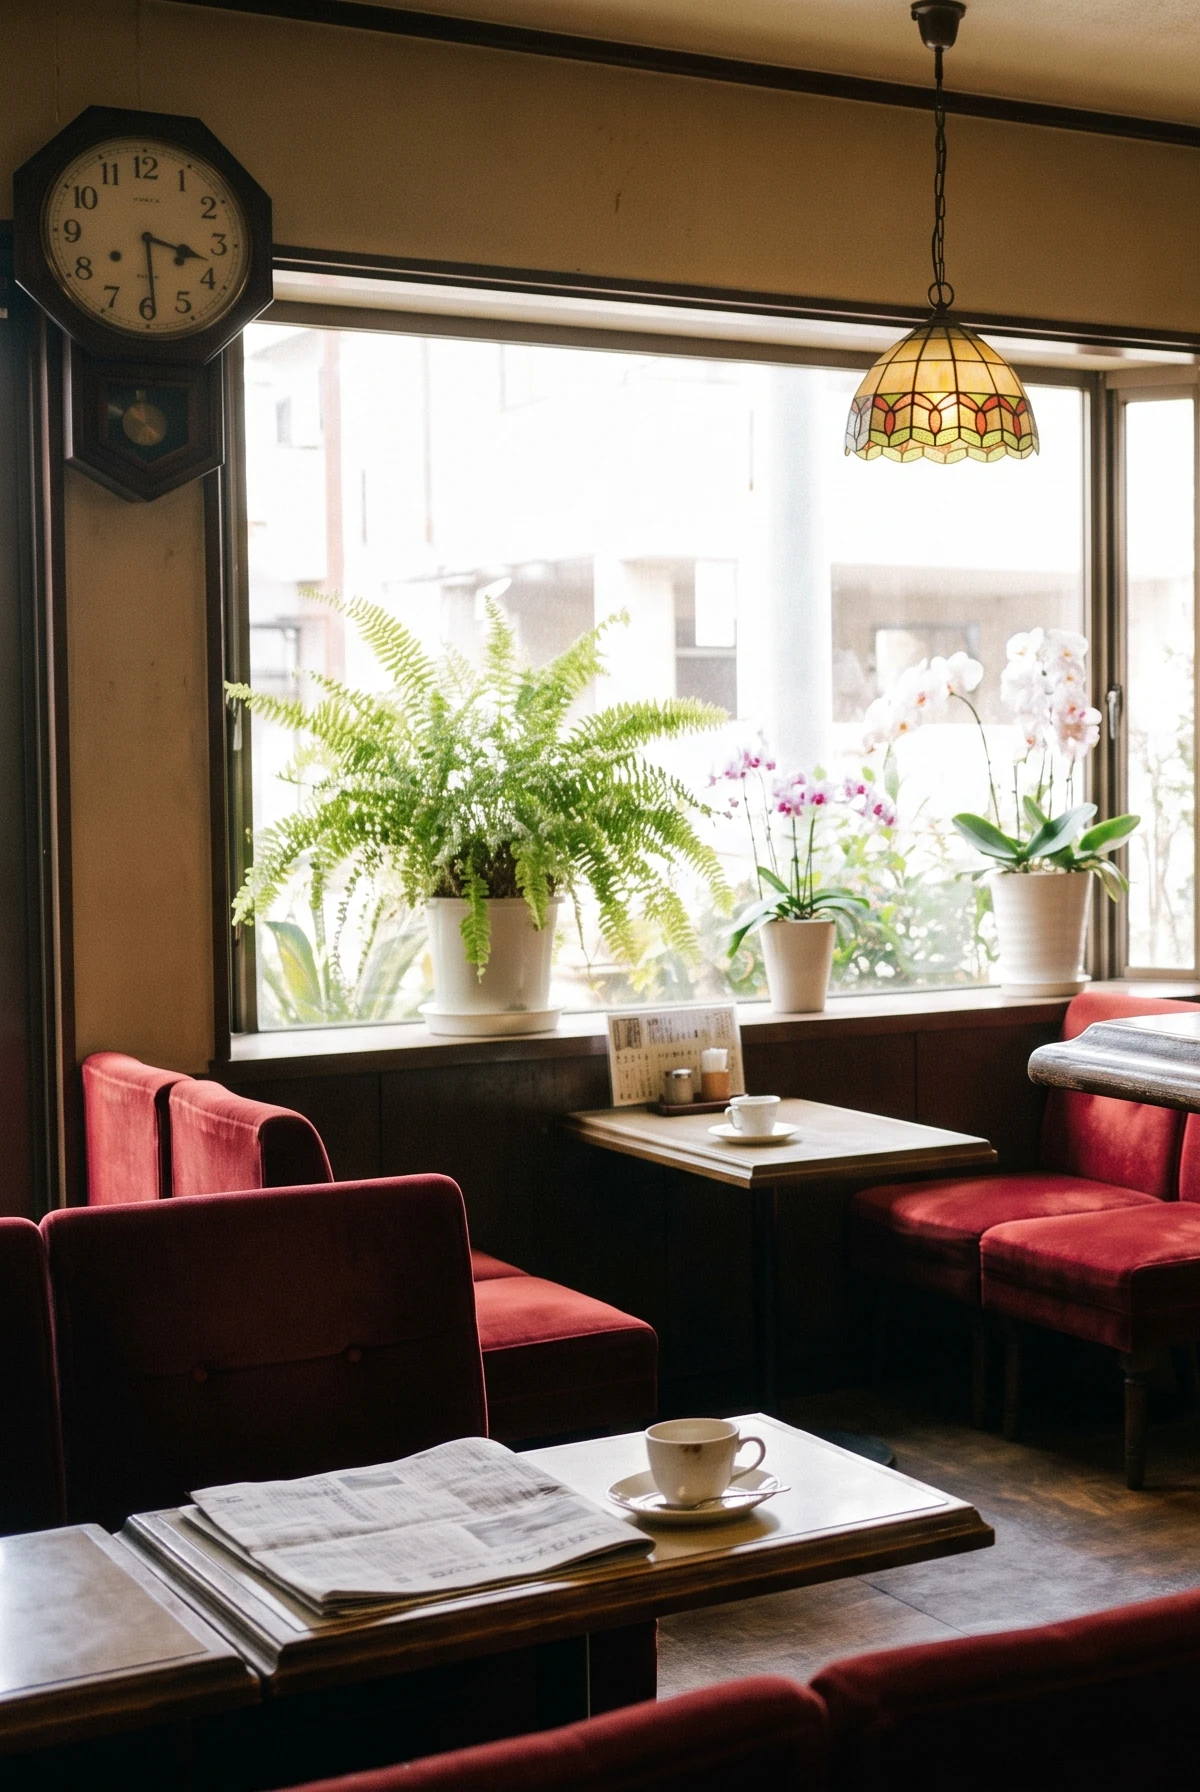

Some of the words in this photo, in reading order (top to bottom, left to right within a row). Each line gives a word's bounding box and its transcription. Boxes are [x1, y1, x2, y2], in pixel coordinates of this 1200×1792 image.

[102, 161, 120, 186] 11
[133, 155, 159, 181] 12
[178, 168, 186, 192] 1
[74, 185, 98, 210] 10
[201, 196, 218, 220] 2
[63, 219, 82, 243] 9
[210, 232, 227, 256] 3
[75, 256, 93, 280] 8
[200, 267, 215, 290] 4
[103, 285, 120, 309] 7
[139, 296, 157, 321] 6
[175, 291, 192, 314] 5
